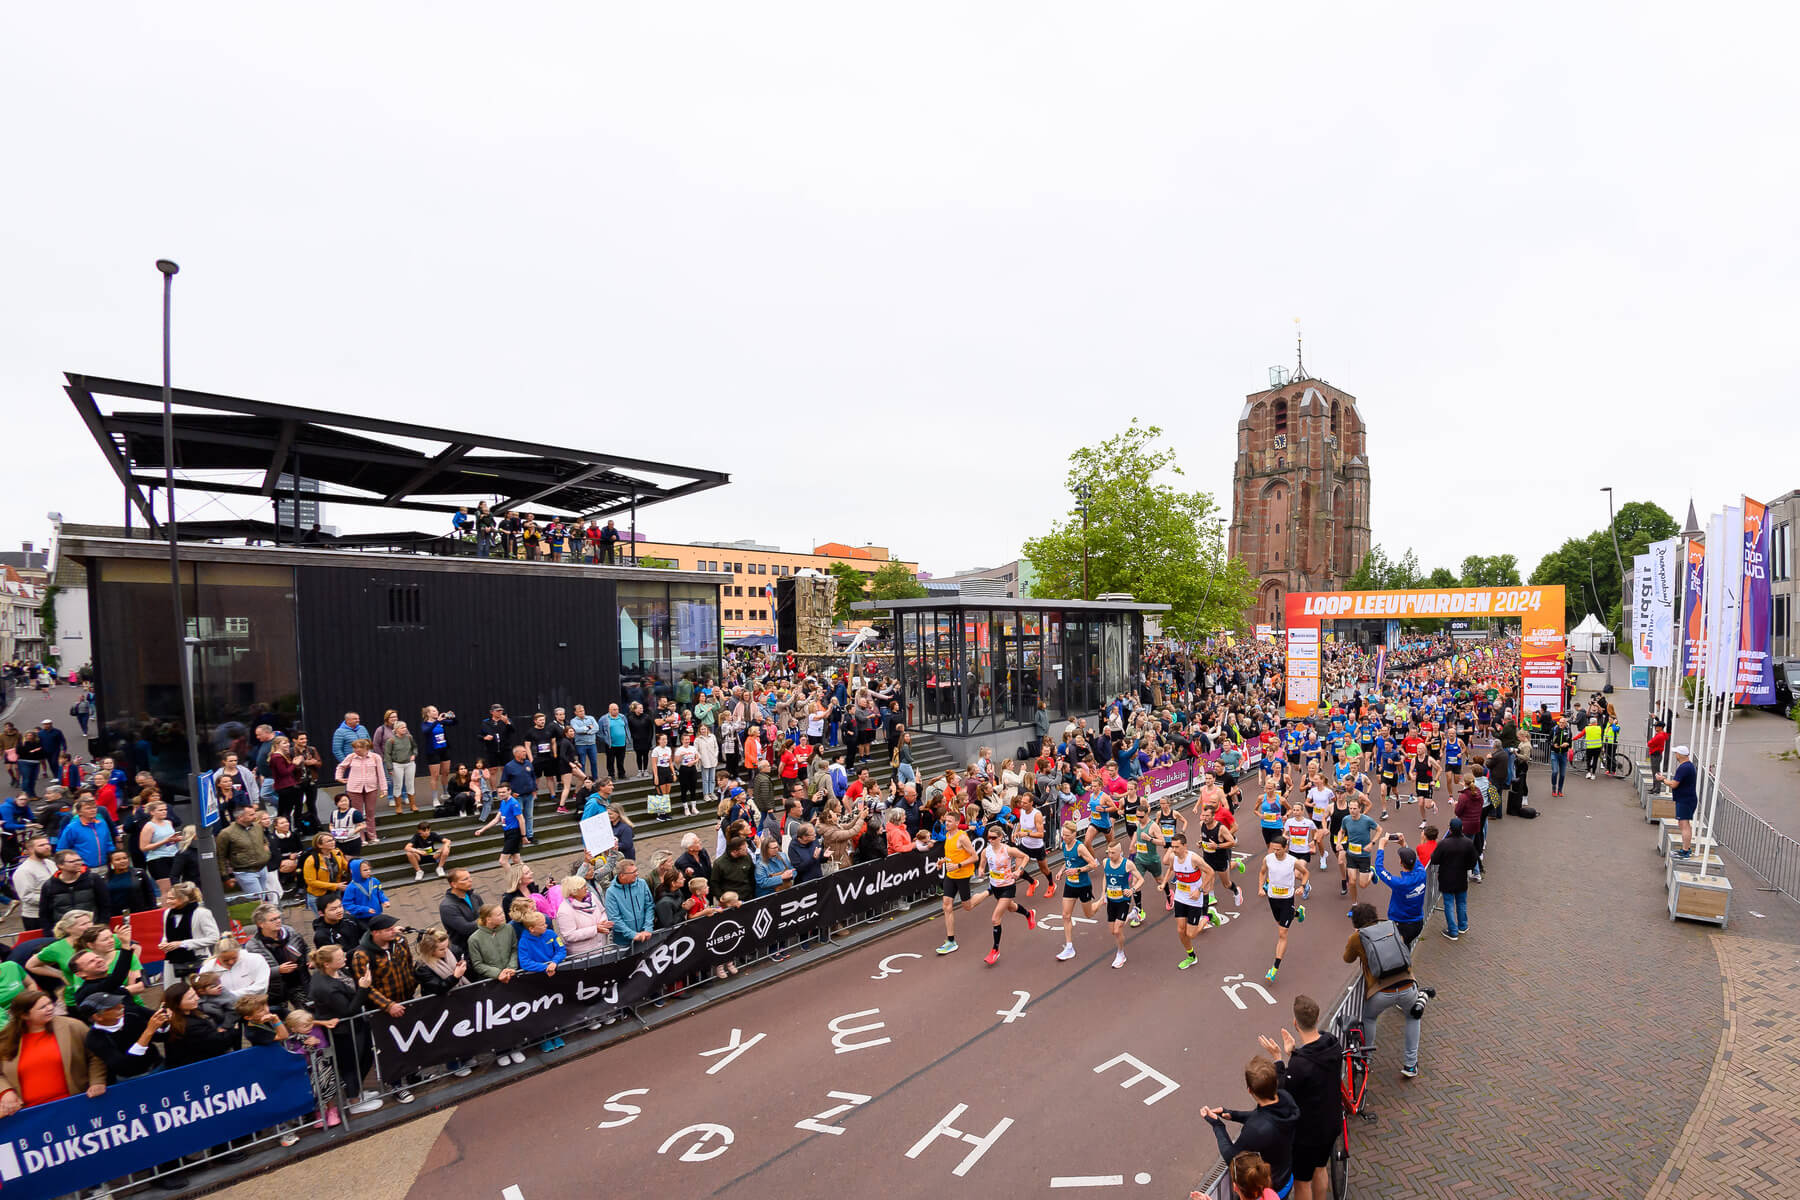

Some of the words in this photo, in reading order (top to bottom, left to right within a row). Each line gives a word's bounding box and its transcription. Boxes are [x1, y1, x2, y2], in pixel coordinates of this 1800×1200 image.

[1304, 596, 1352, 615] LOOP
[1354, 592, 1492, 614] LEEUWARDEN
[1494, 590, 1541, 612] 2024
[836, 866, 920, 905] Welkom
[925, 856, 946, 879] bj
[706, 928, 746, 948] NISSAN
[778, 911, 820, 929] DACIA
[389, 992, 564, 1053] Welkom
[576, 979, 619, 1004] bij
[628, 936, 696, 979] ABD
[19, 1085, 210, 1151] BOUWGROEP
[23, 1118, 150, 1174] DIJKSTRA
[153, 1082, 267, 1134] DRAISMA
